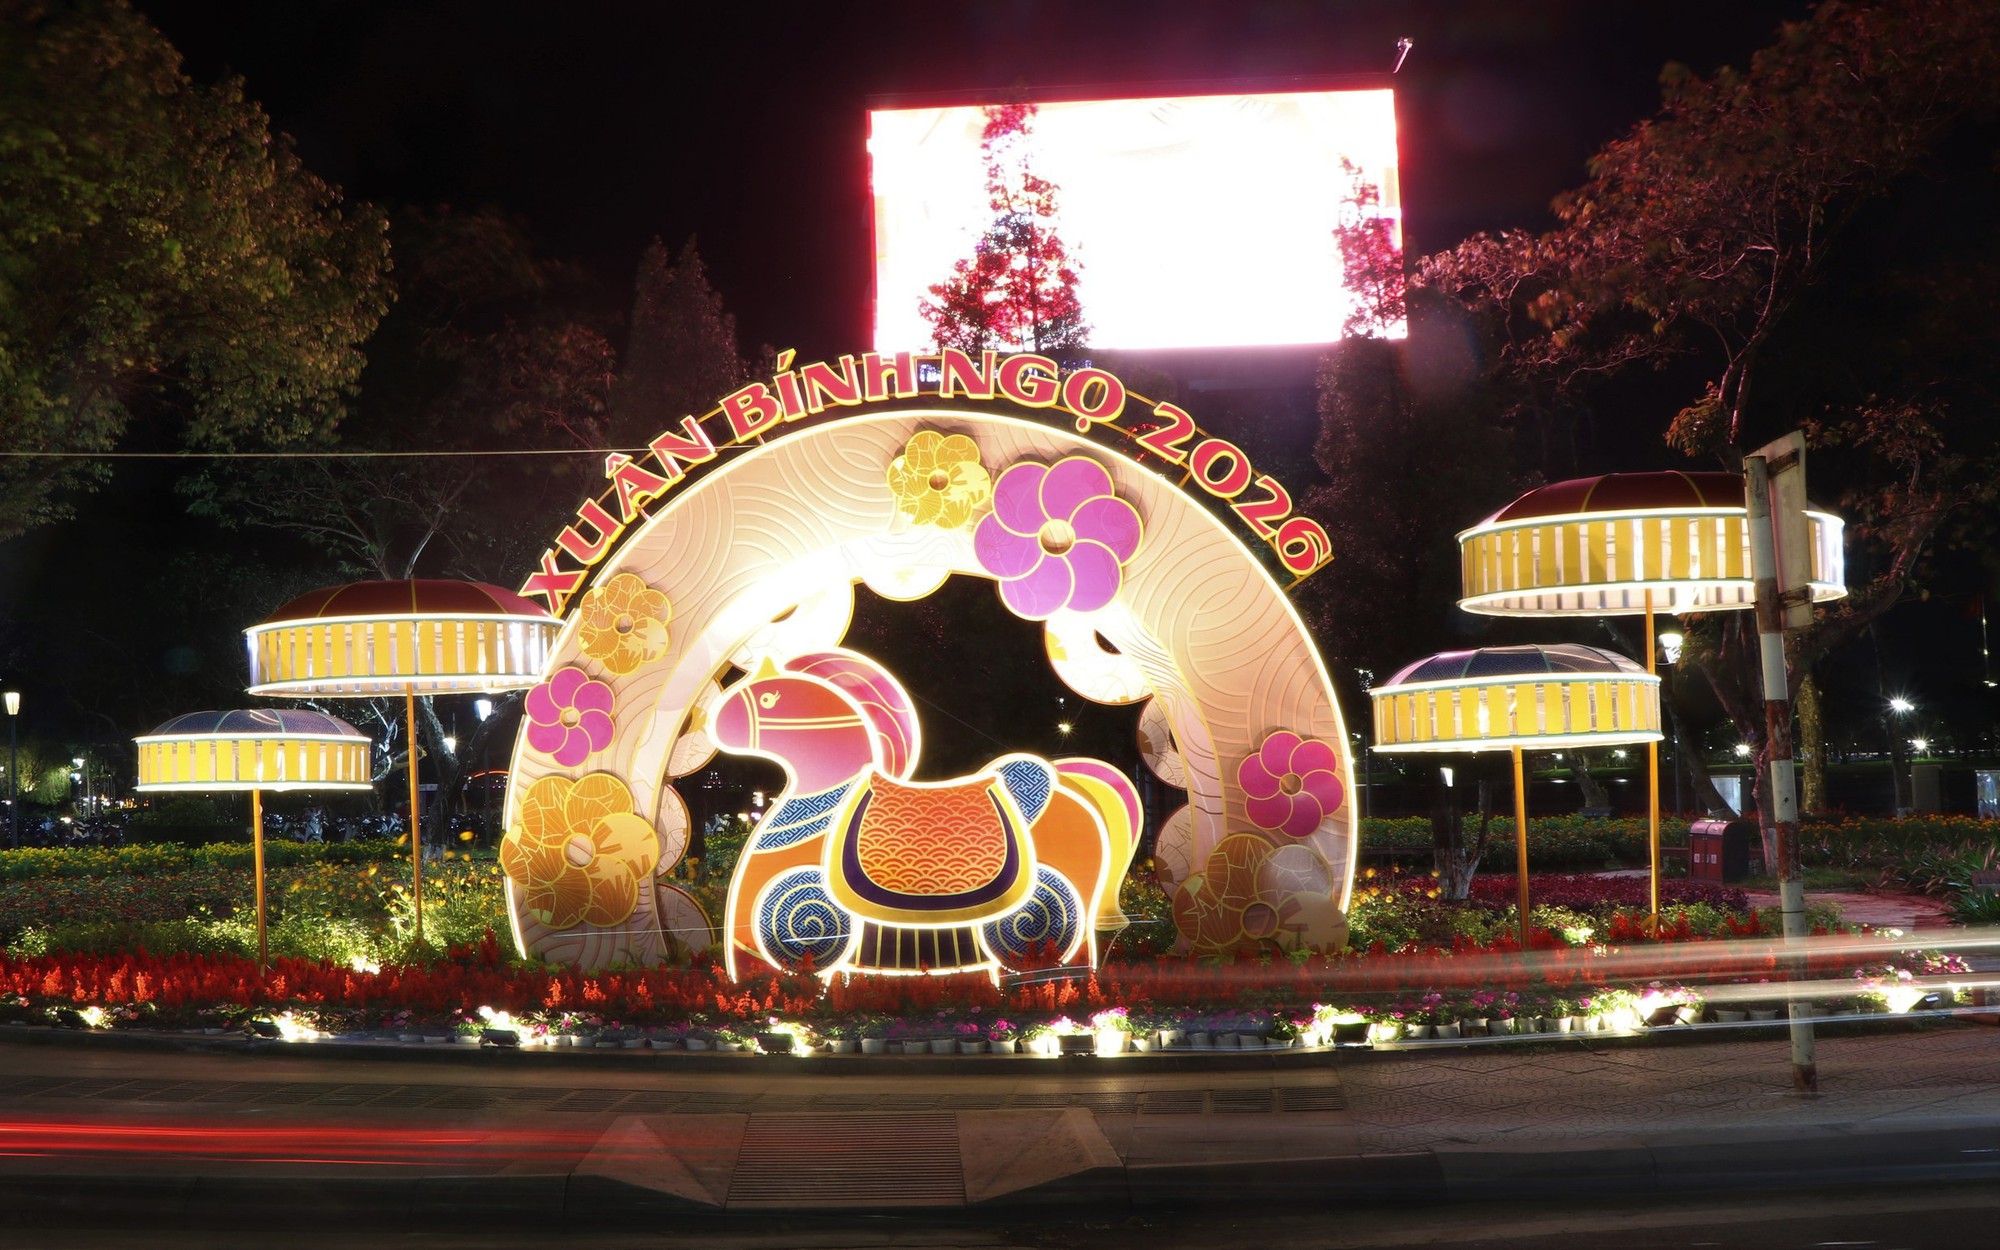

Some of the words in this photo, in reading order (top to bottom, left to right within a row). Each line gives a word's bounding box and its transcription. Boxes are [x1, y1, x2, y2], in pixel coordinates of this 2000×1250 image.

[518, 415, 718, 618] XUÂN
[719, 349, 919, 444] BÍNH
[939, 347, 1126, 433] NGỌ
[1136, 402, 1332, 576] 2026
